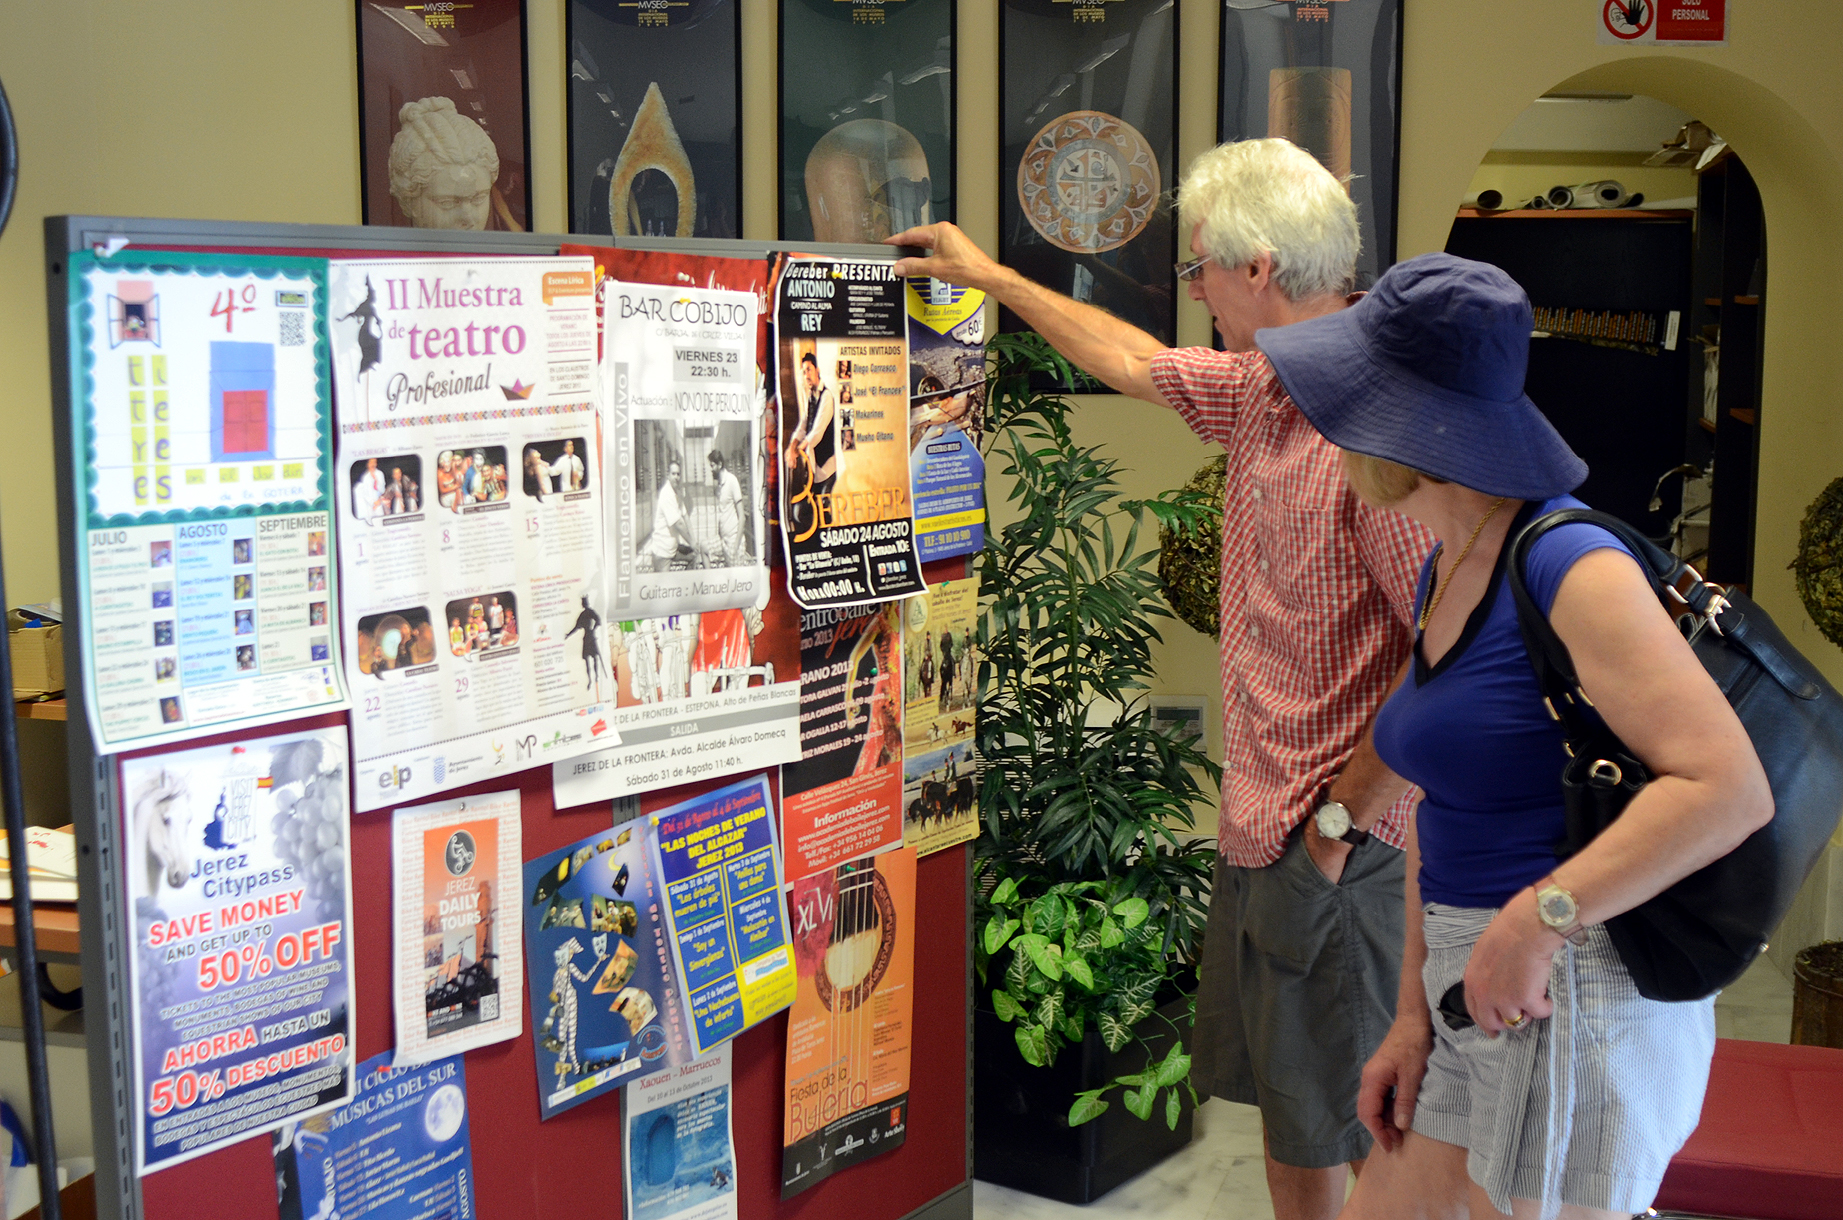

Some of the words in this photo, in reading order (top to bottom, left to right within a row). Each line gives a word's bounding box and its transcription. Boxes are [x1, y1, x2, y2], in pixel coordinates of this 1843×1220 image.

[1672, 10, 1710, 20] PERSONAL
[548, 277, 567, 285] Escena
[568, 276, 584, 284] Lírica
[786, 262, 828, 279] Bereber
[386, 278, 410, 310] II
[417, 277, 524, 310] Muestra
[787, 280, 835, 298] ANTONIO
[620, 295, 666, 322] BAR
[670, 300, 747, 326] COBIJO
[790, 302, 811, 310] CAMINO
[924, 307, 941, 316] Rutas
[942, 307, 962, 316] Aéreas
[801, 314, 822, 332] REY
[968, 320, 979, 336] 60
[388, 321, 404, 339] de
[408, 321, 526, 360] teatro
[676, 350, 723, 362] VIERNES
[727, 353, 738, 363] 23
[840, 346, 867, 356] ARTISTAS
[869, 346, 901, 356] INVITADOS
[691, 366, 718, 376] 22:30
[722, 368, 731, 377] h.
[854, 364, 868, 374] Diego
[870, 364, 896, 372] Carrasco
[387, 363, 492, 411] Profesional
[854, 386, 868, 396] José
[616, 374, 628, 428] Vivo
[674, 392, 702, 412] NONO
[704, 392, 714, 412] DE
[856, 408, 884, 420] Makarines
[857, 433, 874, 442] Musho
[876, 432, 894, 442] Gitano
[620, 438, 630, 466] en
[791, 448, 906, 542] BEREBER
[180, 523, 228, 539] AGOSTO
[260, 516, 326, 532] SEPTIEMBRE
[526, 518, 540, 532] 15
[92, 531, 127, 546] JULIO
[442, 529, 450, 543] 8
[618, 476, 630, 598] Flamenco
[820, 527, 859, 548] SÁBADO
[860, 526, 872, 542] 24
[872, 521, 909, 540] AGOSTO
[868, 544, 897, 558] ENTRADA
[640, 584, 682, 600] Guitarra
[692, 580, 730, 596] Manuel
[732, 578, 752, 592] Jero
[797, 586, 824, 601] HORA
[823, 579, 854, 598] 00:00
[814, 628, 834, 646] 2013
[831, 660, 854, 676] 2013
[456, 678, 469, 693] 29
[817, 685, 841, 700] GALVAN
[364, 697, 380, 712] 22
[620, 714, 630, 724] DE
[631, 712, 640, 722] LA
[642, 707, 679, 720] FRONTERA
[724, 696, 736, 706] Alto
[738, 696, 747, 704] de
[748, 691, 769, 703] Peñas
[771, 688, 796, 700] Blancas
[816, 702, 846, 718] CARRASCO
[670, 724, 698, 736] SALIDA
[806, 725, 830, 739] OGALLA
[572, 762, 597, 774] JEREZ
[599, 760, 610, 770] DE
[612, 757, 622, 768] LA
[624, 750, 668, 766] FRONTERA:
[670, 746, 694, 758] Avda.
[696, 740, 726, 753] Alcalde
[728, 733, 752, 746] Álvaro
[754, 728, 786, 742] Domecq
[814, 740, 842, 755] MORALES
[626, 773, 659, 787] Sábado
[661, 770, 670, 780] 31
[672, 767, 684, 778] de
[686, 762, 714, 777] Agosto
[716, 758, 734, 769] 11:40
[736, 756, 744, 766] h.
[814, 799, 876, 828] Información
[661, 838, 686, 852] "LAS
[687, 824, 720, 844] NOCHES
[722, 819, 733, 832] DE
[734, 807, 766, 827] VERANO
[688, 844, 706, 858] DEL
[707, 827, 748, 852] ALCAZAR"
[189, 853, 248, 878] Jerez
[696, 850, 724, 869] JEREZ
[725, 842, 744, 858] 2013
[203, 865, 294, 898] Citypass
[445, 876, 476, 896] JEREZ
[670, 882, 688, 895] Sábado
[439, 892, 481, 916] DAILY
[150, 912, 212, 945] SAVE
[221, 890, 304, 927] MONEY
[440, 911, 482, 930] TOURS
[167, 943, 194, 961] AND
[201, 935, 228, 951] GET
[232, 929, 250, 944] UP
[256, 924, 272, 938] TO
[200, 942, 272, 988] 50%
[276, 924, 340, 967] OFF
[162, 1001, 198, 1018] TICKETS
[202, 998, 212, 1007] TO
[215, 993, 230, 1004] THE
[234, 986, 258, 1000] MOST
[260, 975, 298, 992] POPULAR
[235, 994, 274, 1012] BODEGAS
[276, 990, 286, 1000] OF
[289, 983, 310, 996] WINE
[312, 978, 328, 990] AND
[184, 1018, 238, 1040] EQUESTRIAN
[240, 1008, 269, 1022] SHOWS
[303, 992, 322, 1005] CITY
[164, 1027, 257, 1071] AHORRA
[264, 1018, 306, 1041] HASTA
[310, 1011, 330, 1028] UN
[152, 1069, 224, 1113] 50%
[228, 1036, 344, 1086] DESCUENTO
[640, 1073, 671, 1090] Xaouen
[680, 1056, 722, 1077] Marruecos
[790, 1081, 818, 1103] Fiesta
[822, 1072, 836, 1090] de
[839, 1066, 847, 1082] la
[332, 1087, 395, 1130] MÚSICAS
[398, 1075, 426, 1100] DEL
[429, 1062, 456, 1086] SUR
[790, 1077, 868, 1142] Bulería
